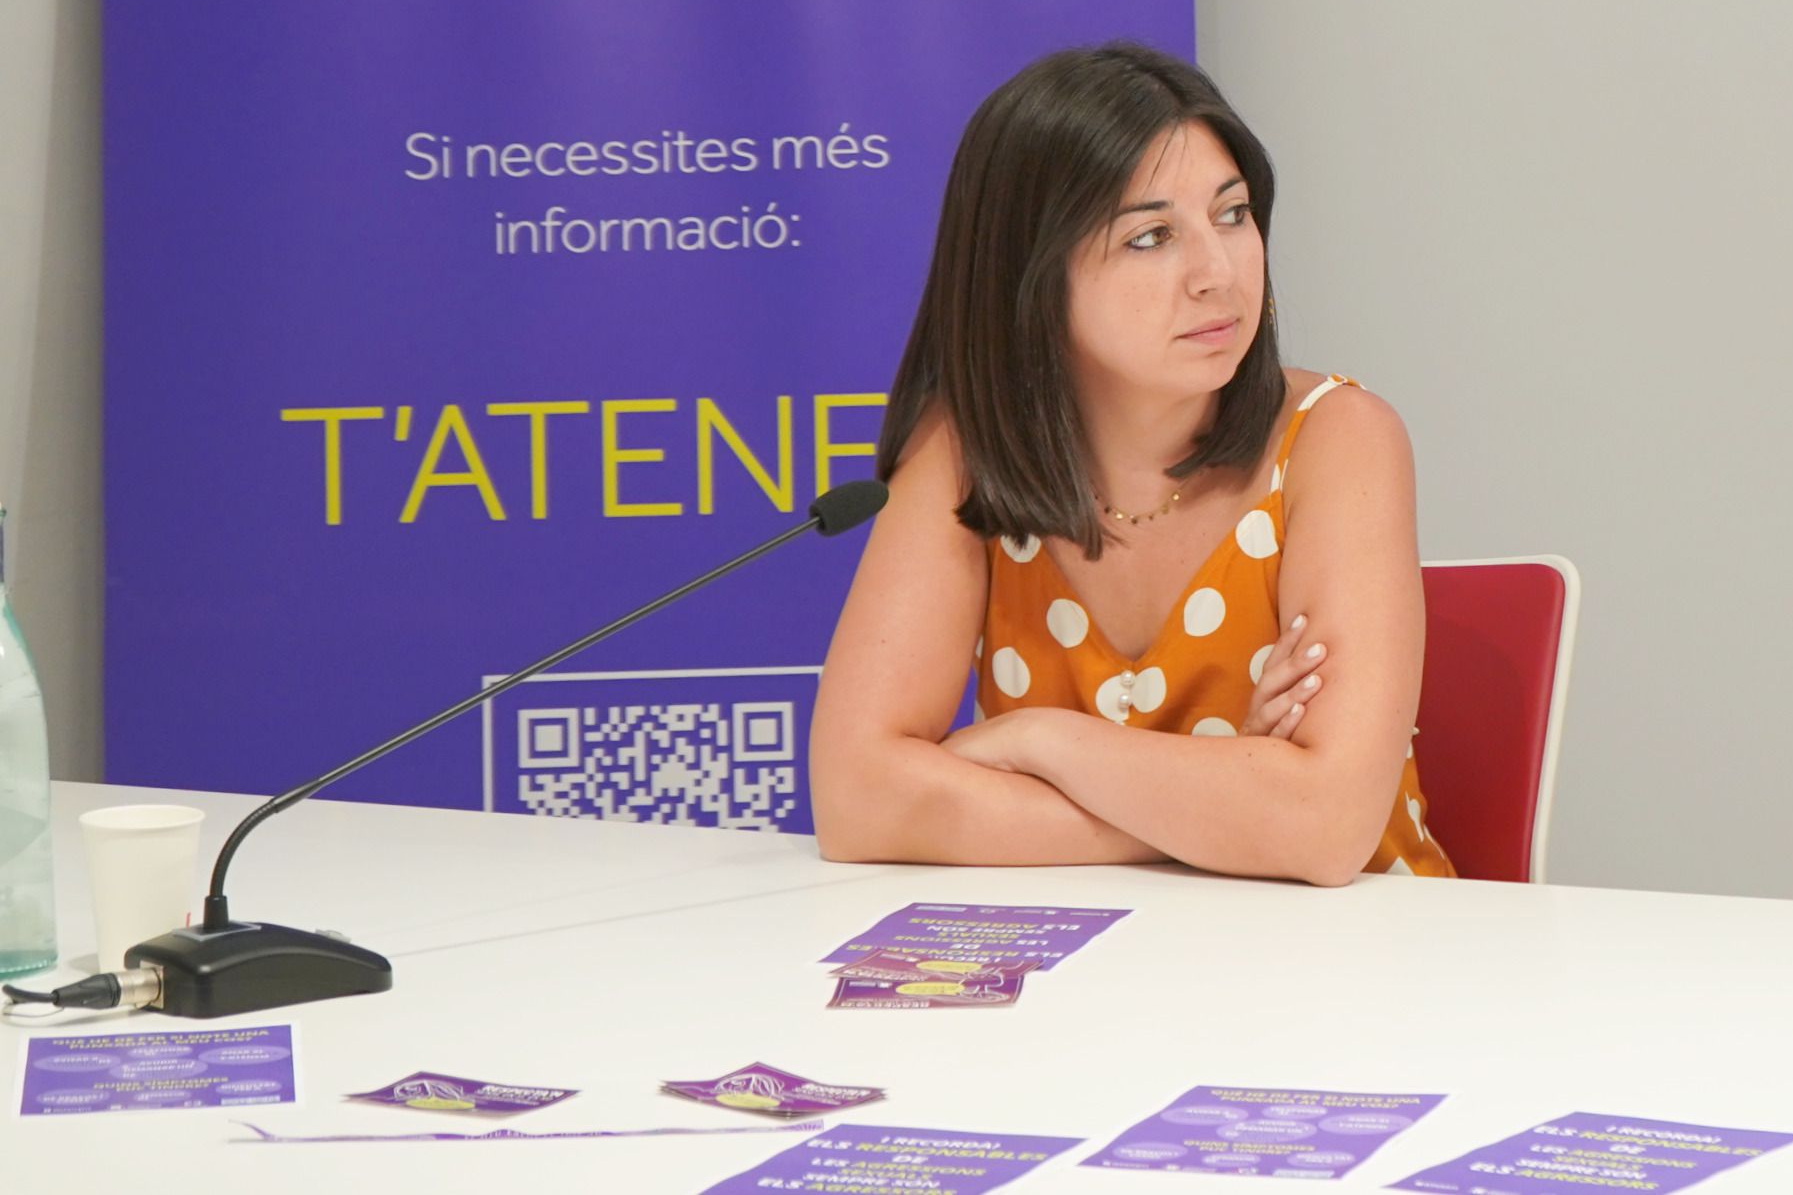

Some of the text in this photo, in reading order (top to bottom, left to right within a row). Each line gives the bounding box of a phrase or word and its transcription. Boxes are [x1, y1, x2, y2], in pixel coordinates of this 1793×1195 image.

[406, 123, 889, 180] Si necessites més
[496, 203, 800, 254] informació:
